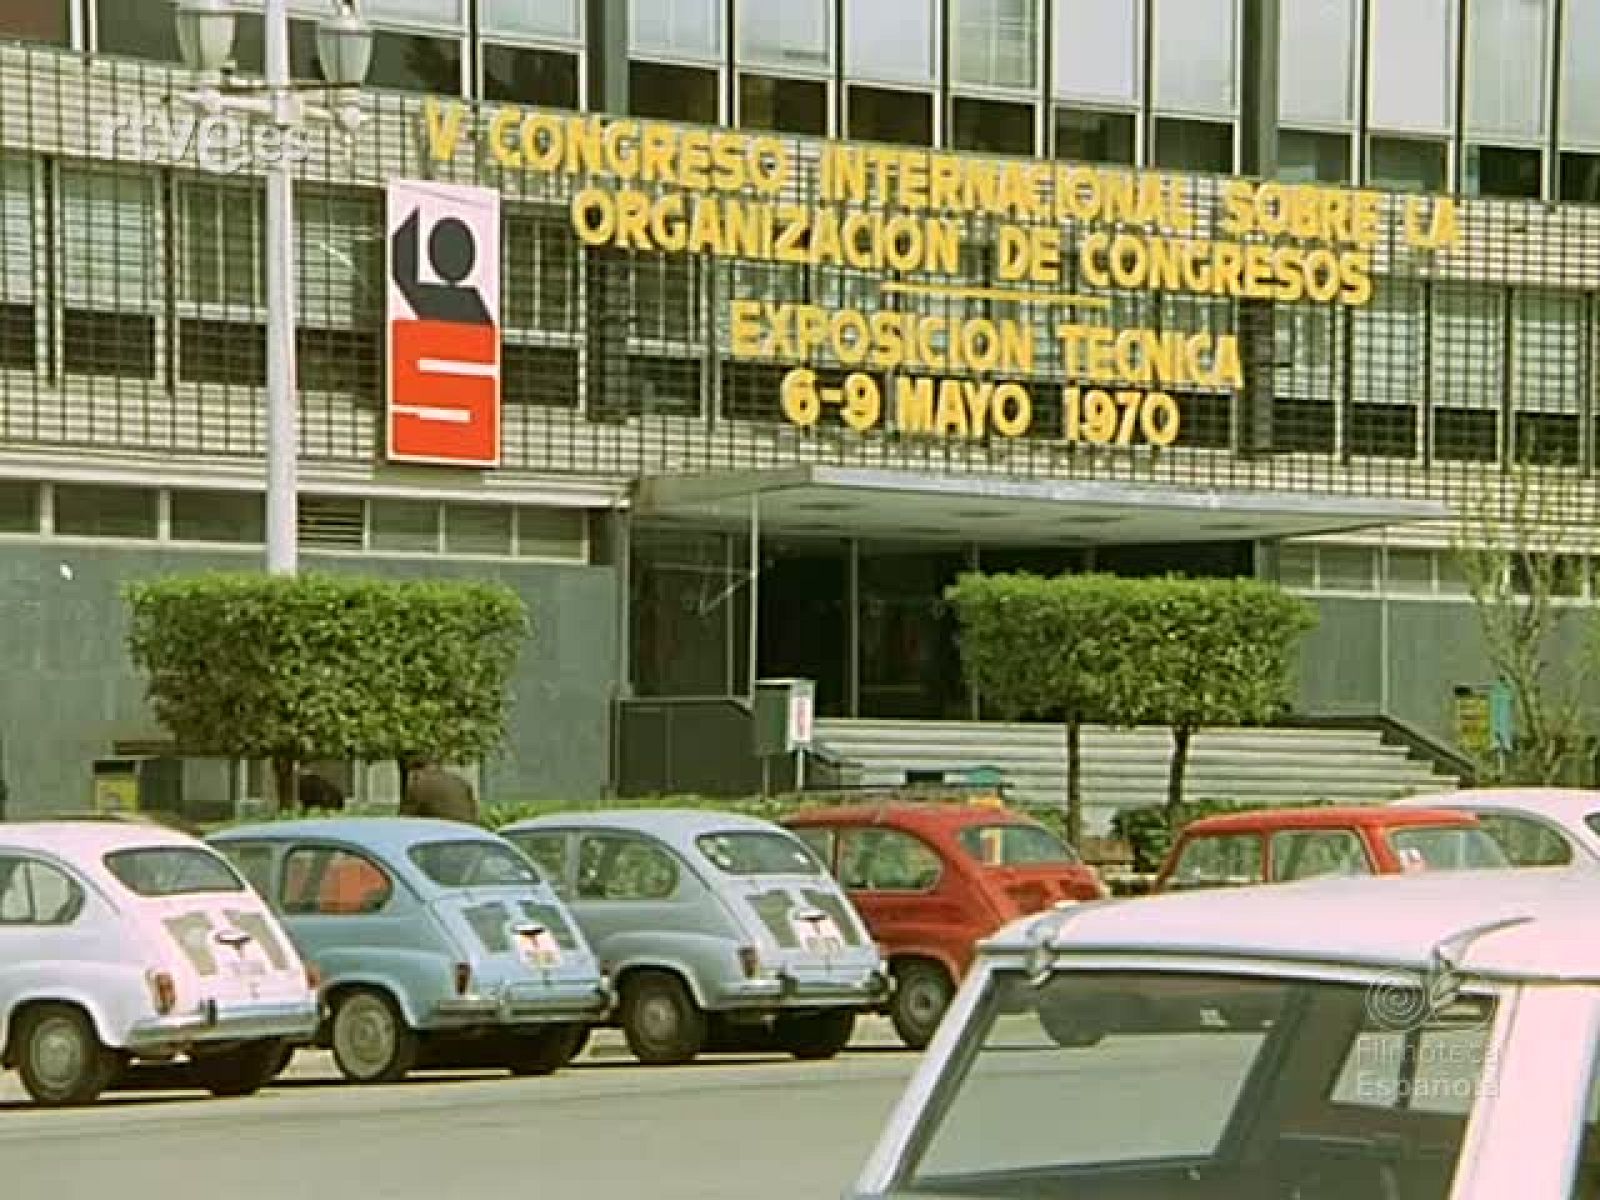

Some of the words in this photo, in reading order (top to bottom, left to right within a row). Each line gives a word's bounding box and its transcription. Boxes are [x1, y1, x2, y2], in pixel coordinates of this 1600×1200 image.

[428, 97, 462, 162] V
[489, 106, 786, 191] CONGRESO
[819, 143, 1192, 232] INTERNACIONAL
[1223, 182, 1379, 244] SOBRE
[1408, 194, 1459, 249] LA
[573, 189, 961, 272] ORGANIZACION
[998, 225, 1060, 282] DE
[1080, 232, 1372, 305] CONGRESOS
[731, 300, 1034, 375] EXPOSICION
[1060, 324, 1244, 389] TECNICA
[780, 368, 880, 430] 6-9
[896, 376, 1032, 438] MAYO
[1062, 386, 1182, 448] 1970
